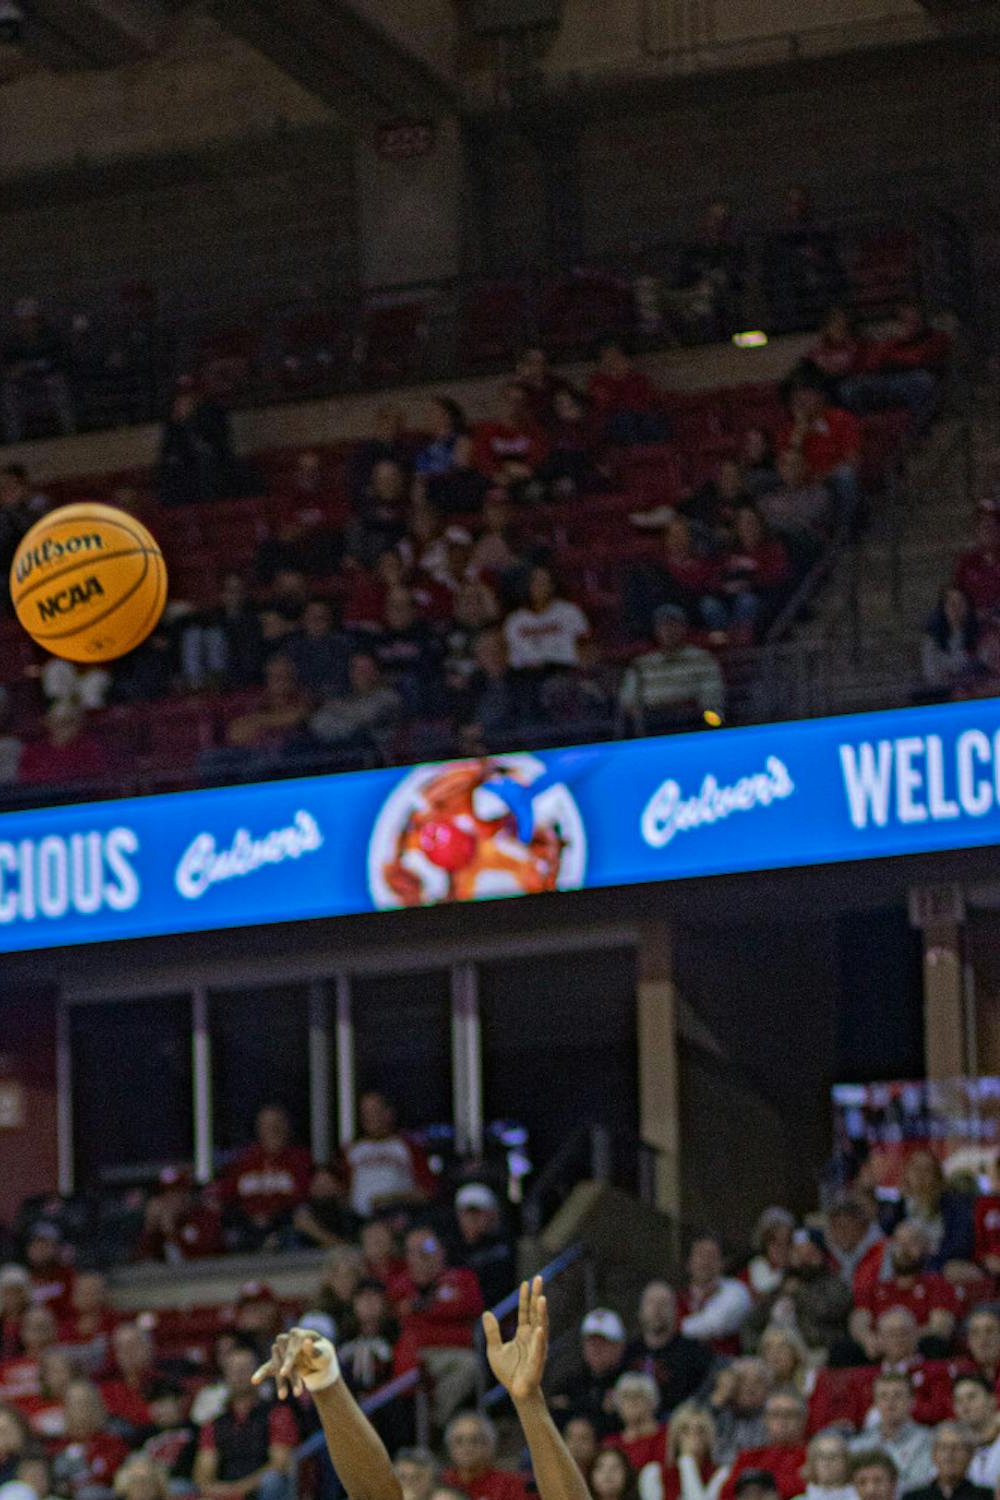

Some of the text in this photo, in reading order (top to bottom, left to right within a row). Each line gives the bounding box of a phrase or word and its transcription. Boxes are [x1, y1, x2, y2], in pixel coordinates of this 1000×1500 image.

[16, 533, 104, 584] Wilson
[36, 576, 104, 622] NCAA
[640, 755, 795, 850] Culver's
[838, 728, 1000, 830] WELC
[175, 808, 323, 900] Culver's
